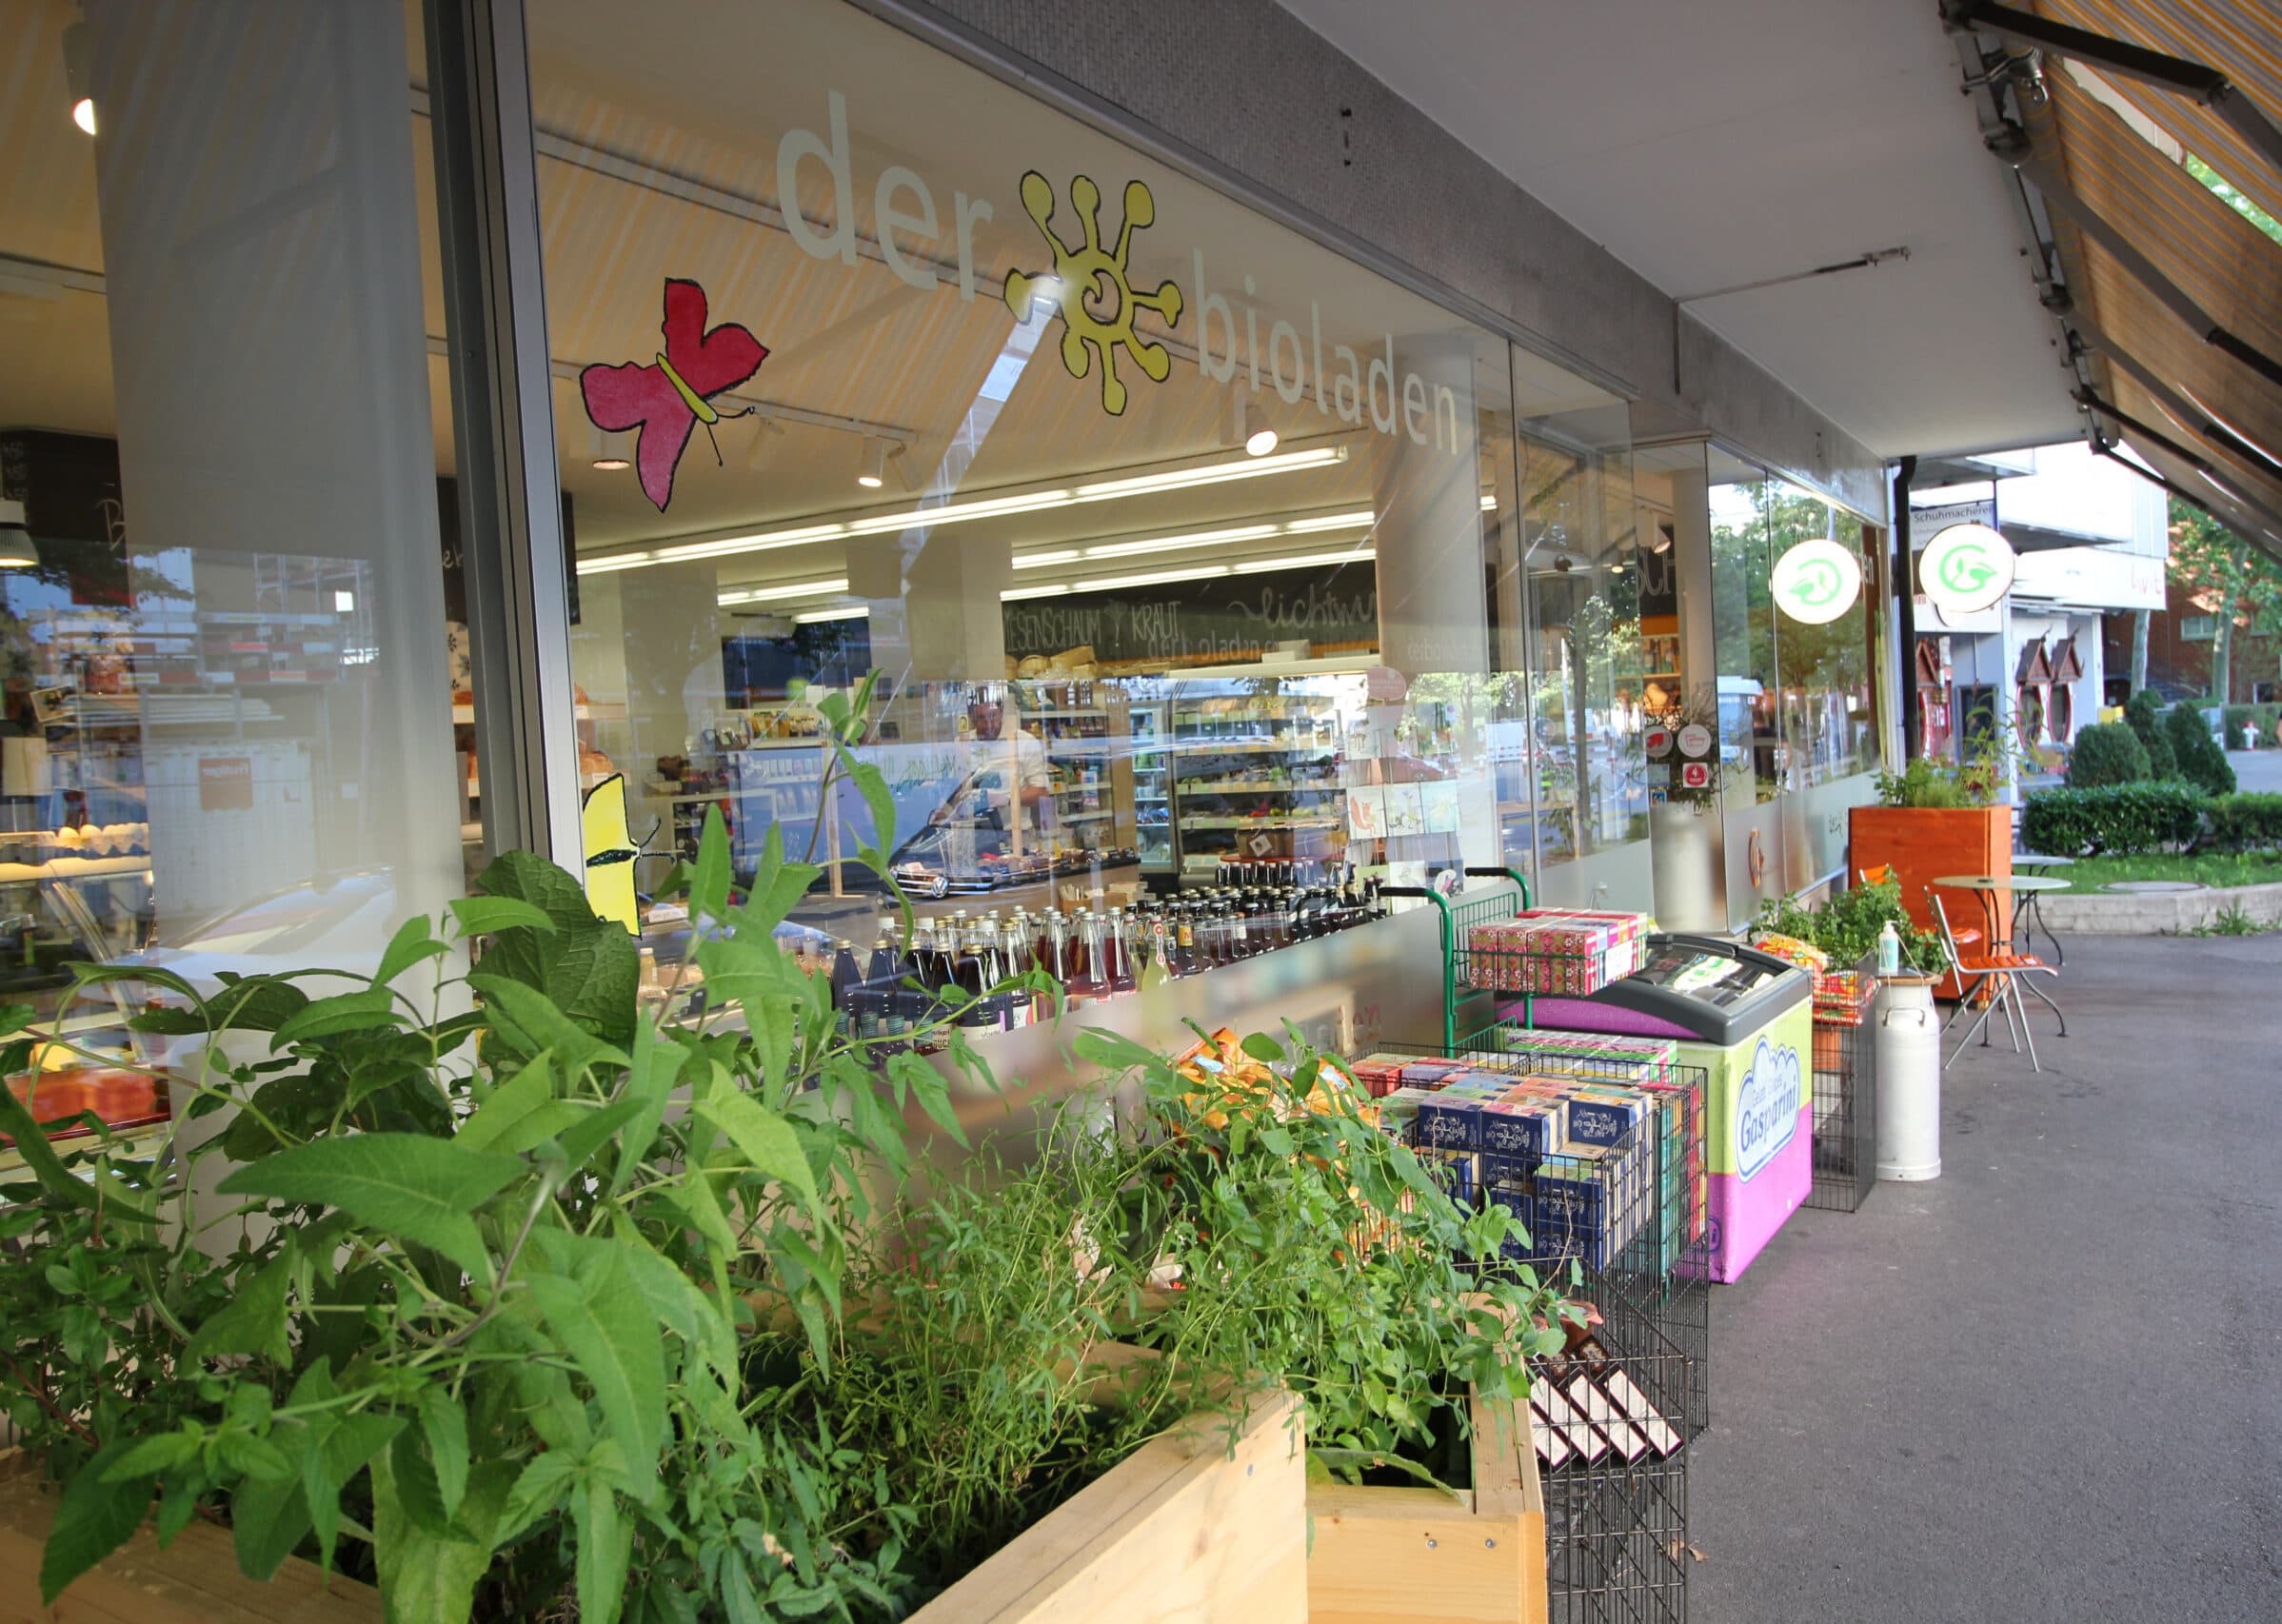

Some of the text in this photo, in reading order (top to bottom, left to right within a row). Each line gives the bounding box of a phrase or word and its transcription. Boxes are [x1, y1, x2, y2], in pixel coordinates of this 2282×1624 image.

[776, 89, 1458, 456] der bioladen
[1131, 601, 1181, 644] KRAUT
[1741, 1074, 1796, 1153] Gasparini
